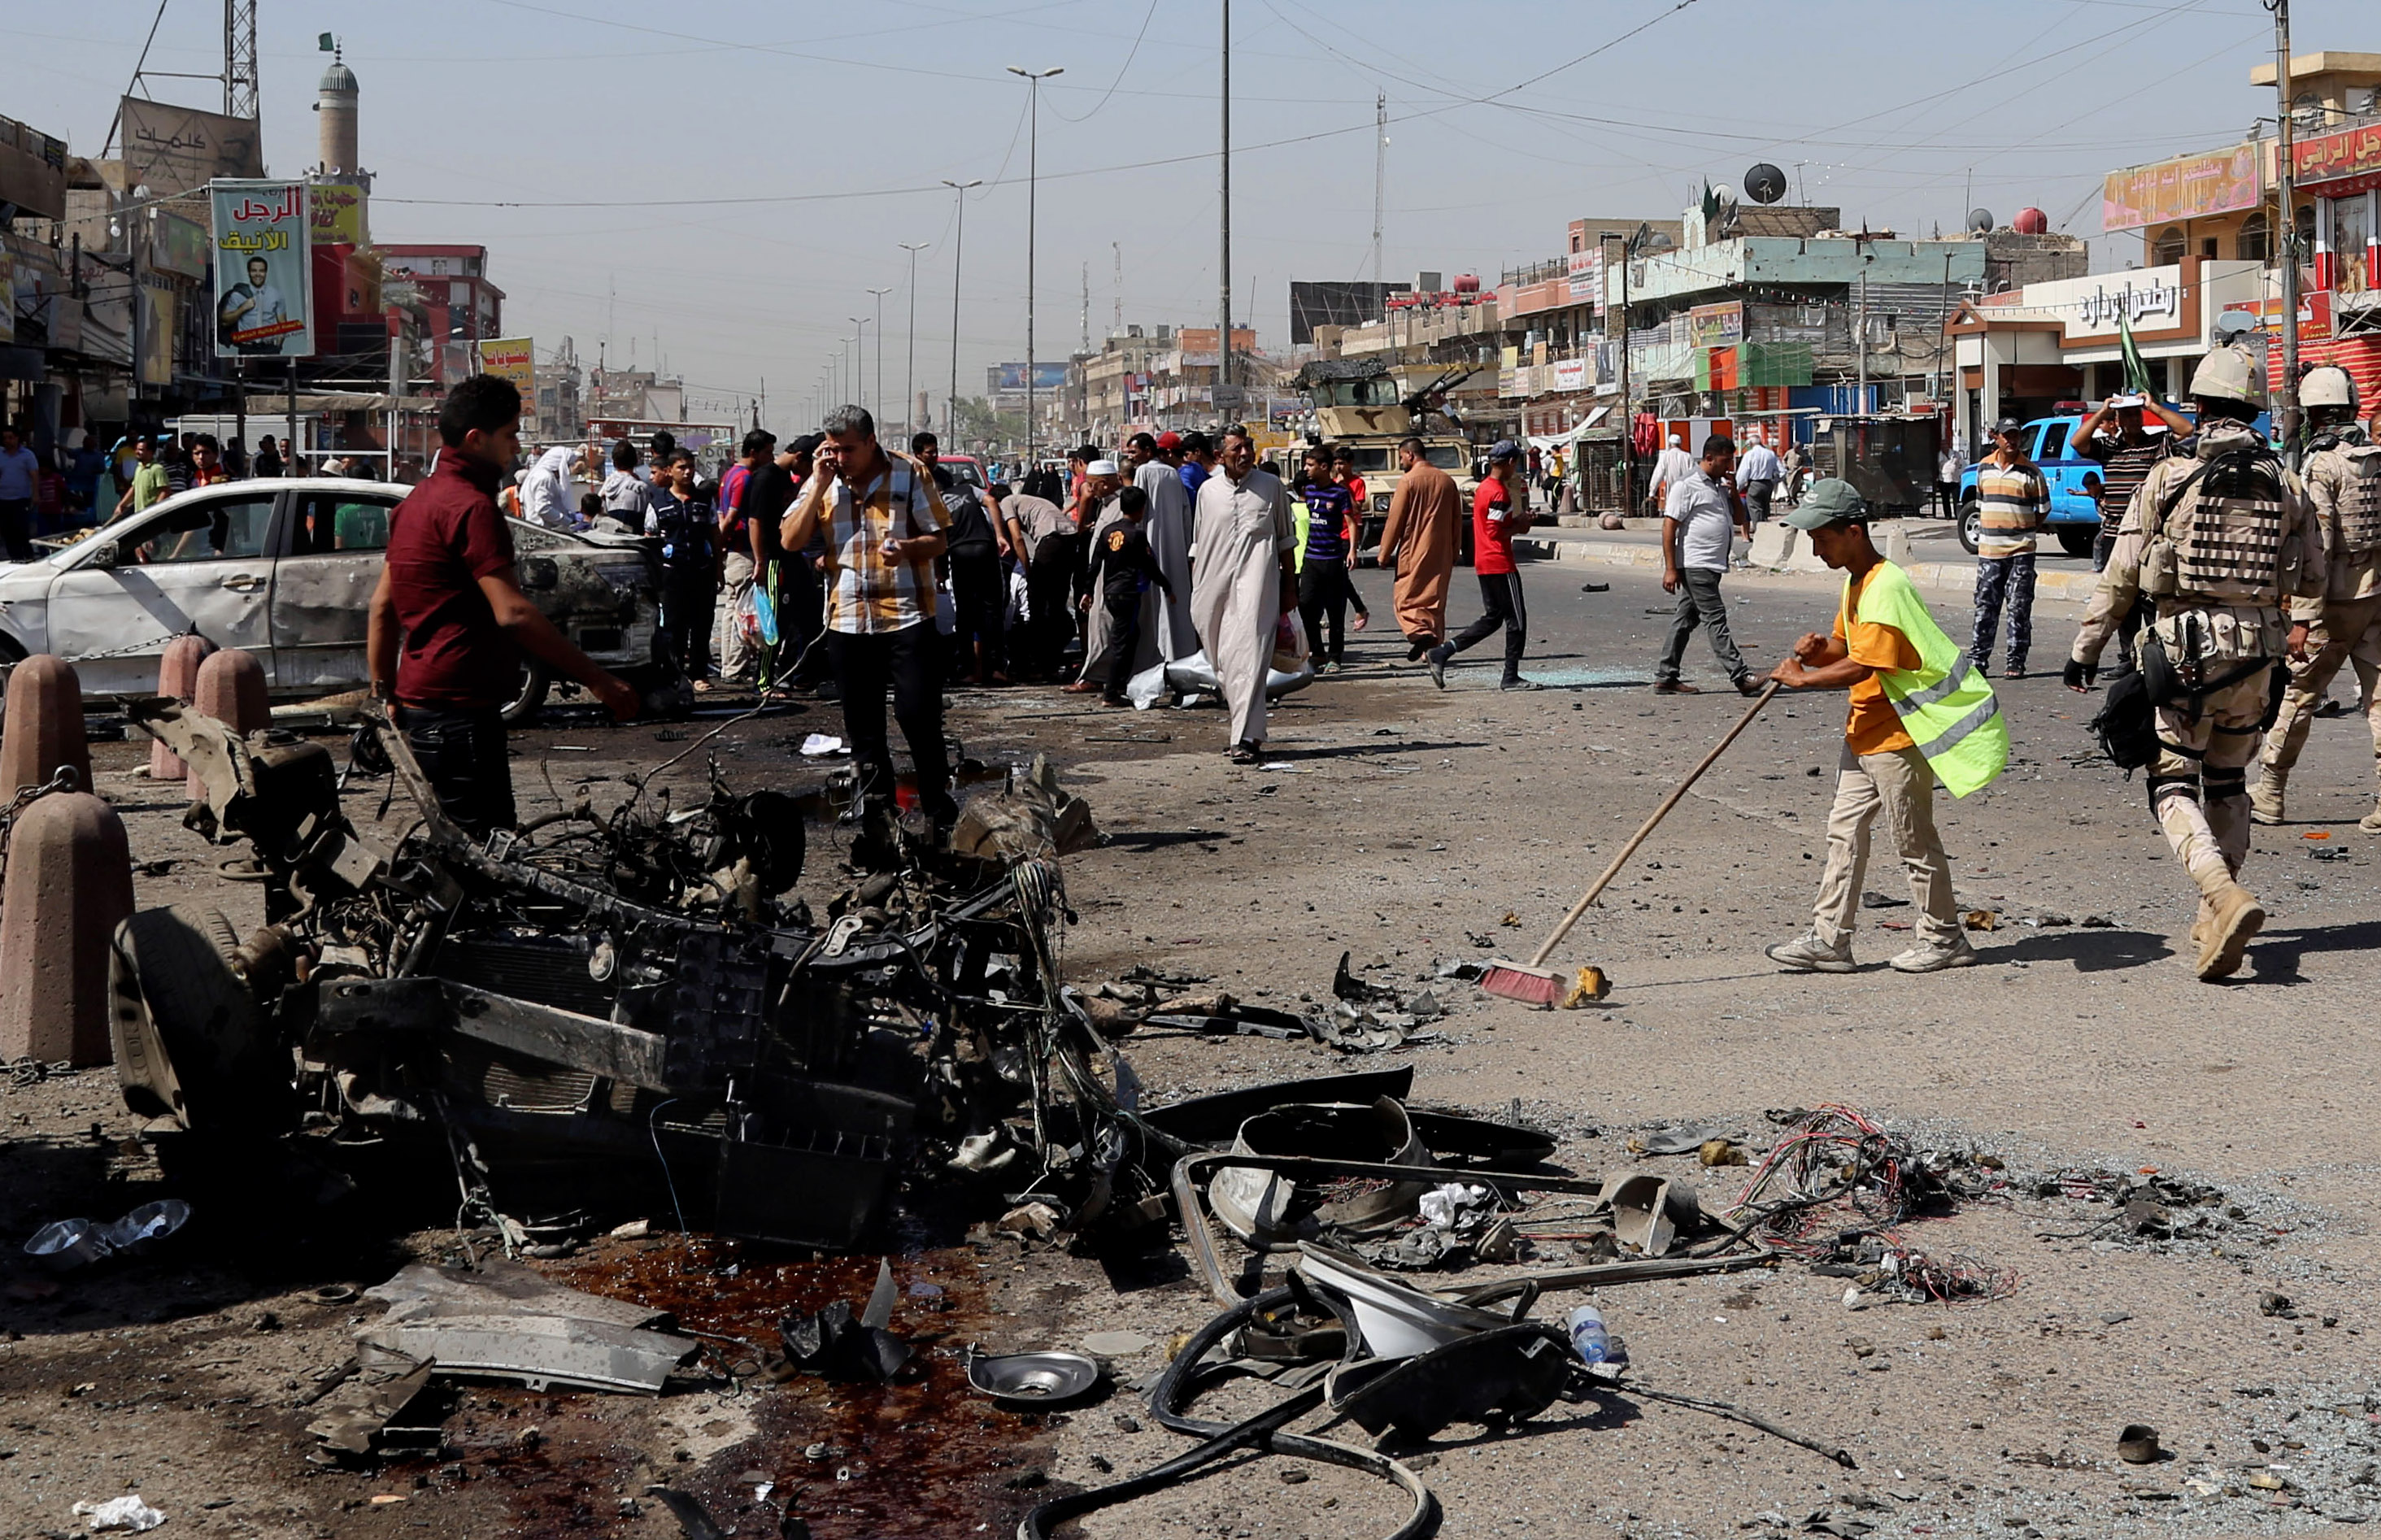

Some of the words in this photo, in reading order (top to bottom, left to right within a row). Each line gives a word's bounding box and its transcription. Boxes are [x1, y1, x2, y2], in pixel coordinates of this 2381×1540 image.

[136, 127, 207, 150] كلمات
[233, 185, 301, 224] الرجل
[218, 226, 289, 254] الأنيق
[2079, 285, 2111, 328] داود
[2131, 278, 2176, 324] مطعم
[485, 347, 529, 368] مشويات
